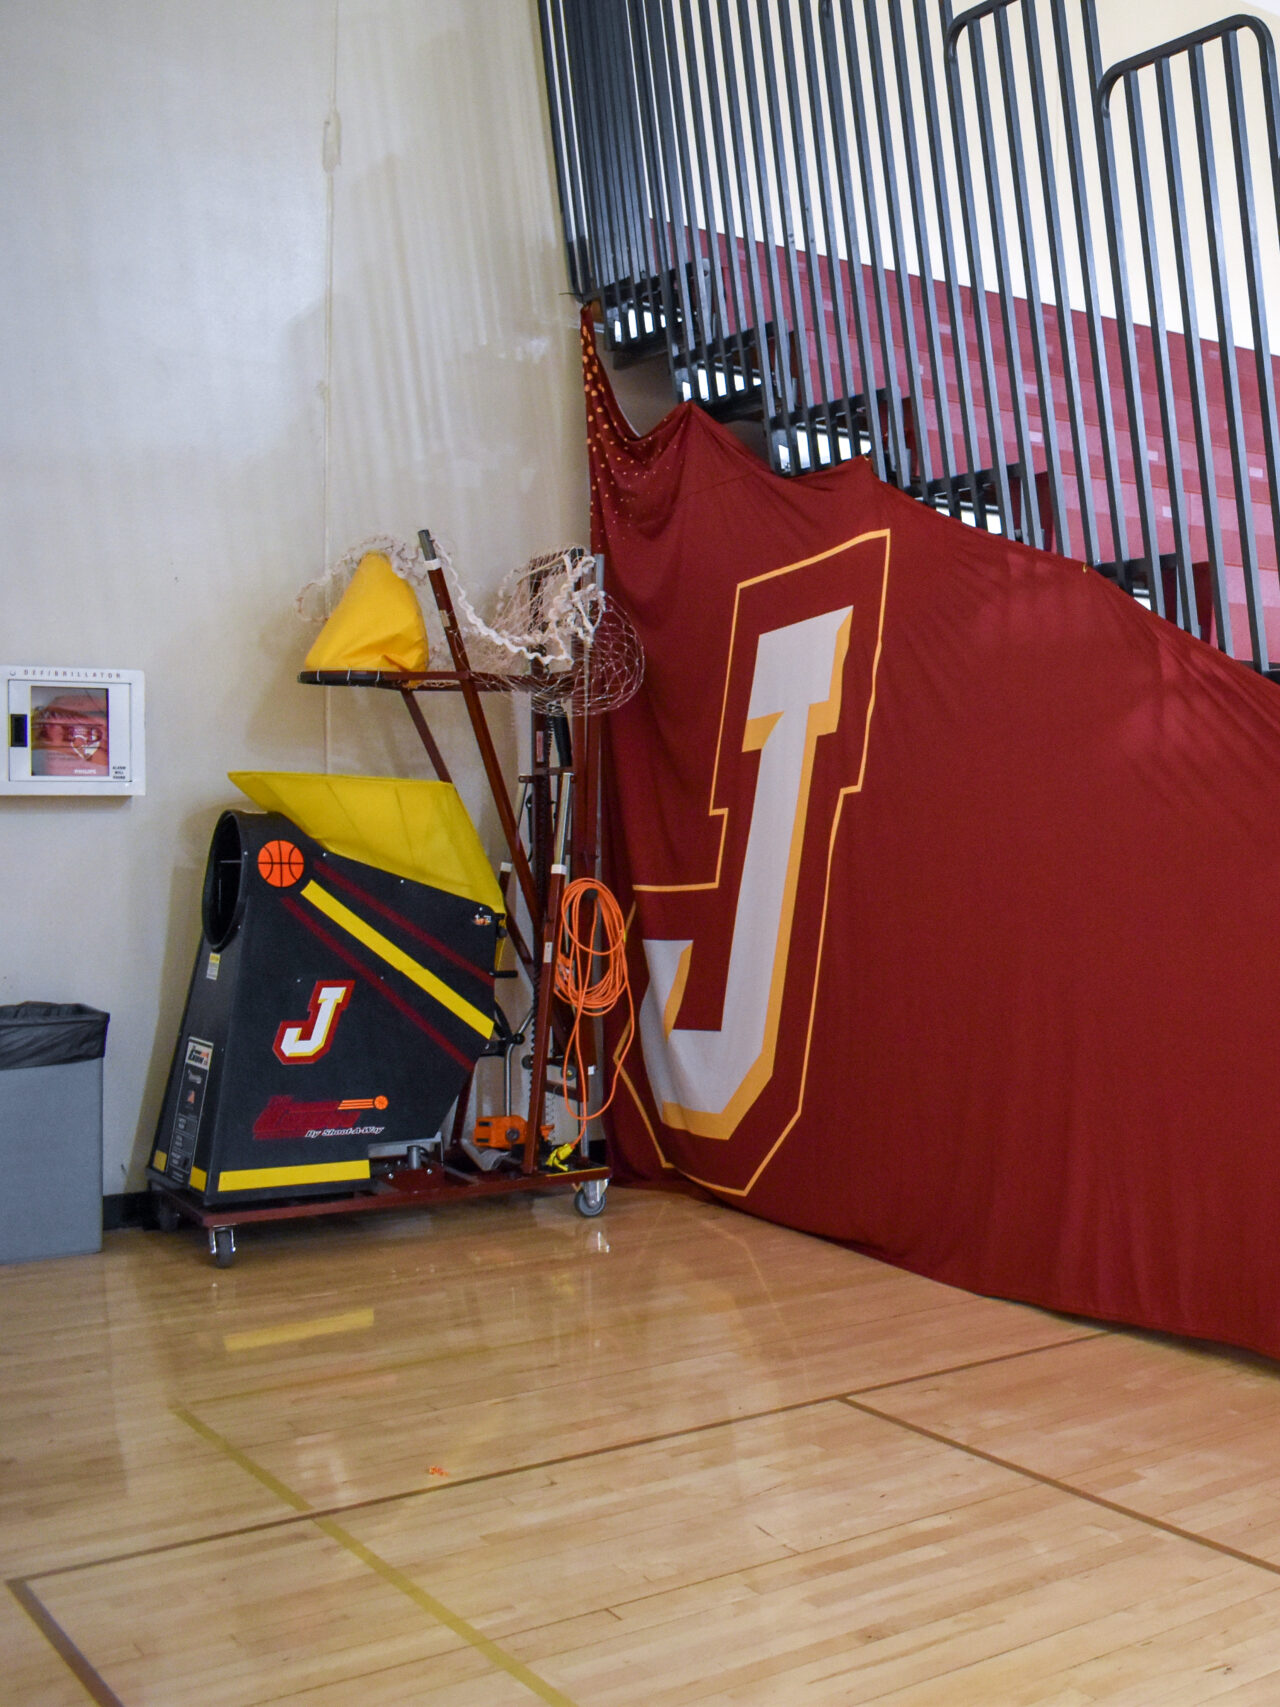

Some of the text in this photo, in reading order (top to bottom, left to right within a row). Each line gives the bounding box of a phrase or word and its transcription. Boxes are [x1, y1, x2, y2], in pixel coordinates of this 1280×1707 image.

[23, 669, 121, 679] DEFIBRILLATOR
[639, 605, 854, 1142] J
[277, 984, 349, 1059] J
[305, 1129, 321, 1139] By
